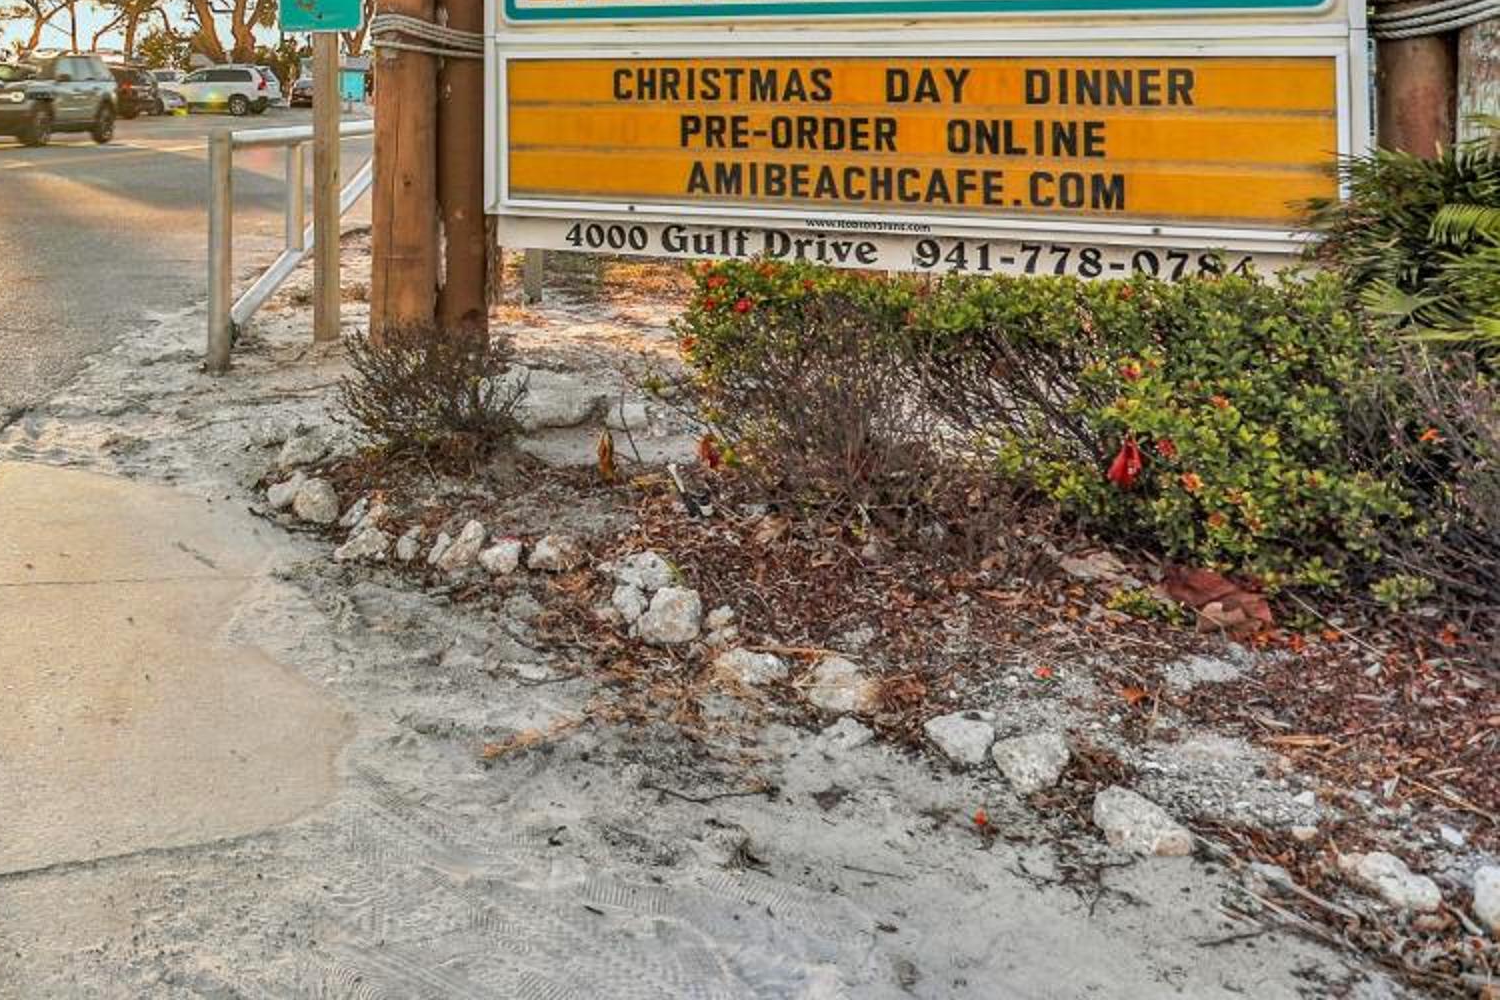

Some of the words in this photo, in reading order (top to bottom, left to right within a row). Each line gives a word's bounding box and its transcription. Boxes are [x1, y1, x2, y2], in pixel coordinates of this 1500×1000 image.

[613, 67, 832, 102] CHRISTMAS
[886, 68, 970, 103] DAY
[1025, 68, 1194, 106] DINNER
[680, 114, 897, 152] PRE-ORDER
[947, 119, 1106, 157] ONLINE
[687, 161, 1125, 210] AMIBEACHCAFE.COM
[566, 223, 649, 251] 4000
[661, 224, 748, 257] Gulf
[770, 229, 878, 264] Drive
